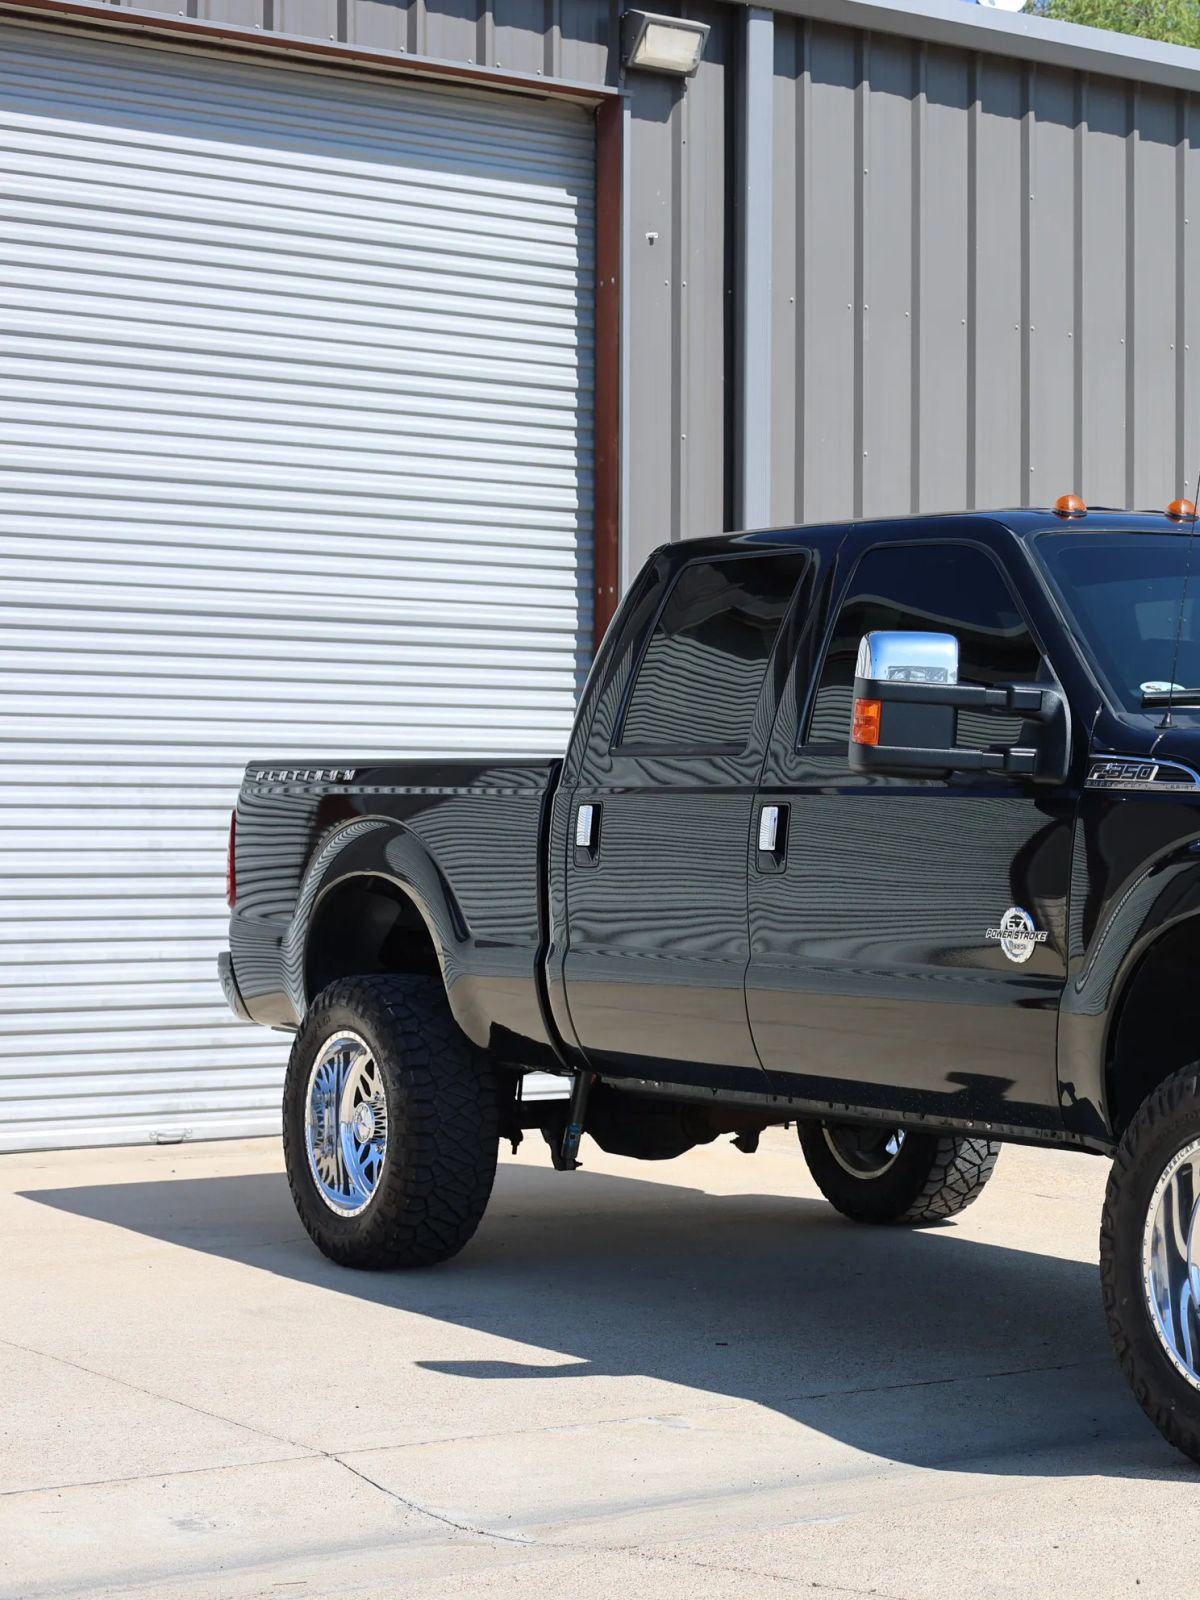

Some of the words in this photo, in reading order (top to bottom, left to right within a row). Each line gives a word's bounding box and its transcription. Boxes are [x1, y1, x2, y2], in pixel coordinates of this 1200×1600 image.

[255, 769, 355, 781] PLATINUM
[986, 929, 1013, 939] POWER
[1014, 931, 1047, 941] STROKE
